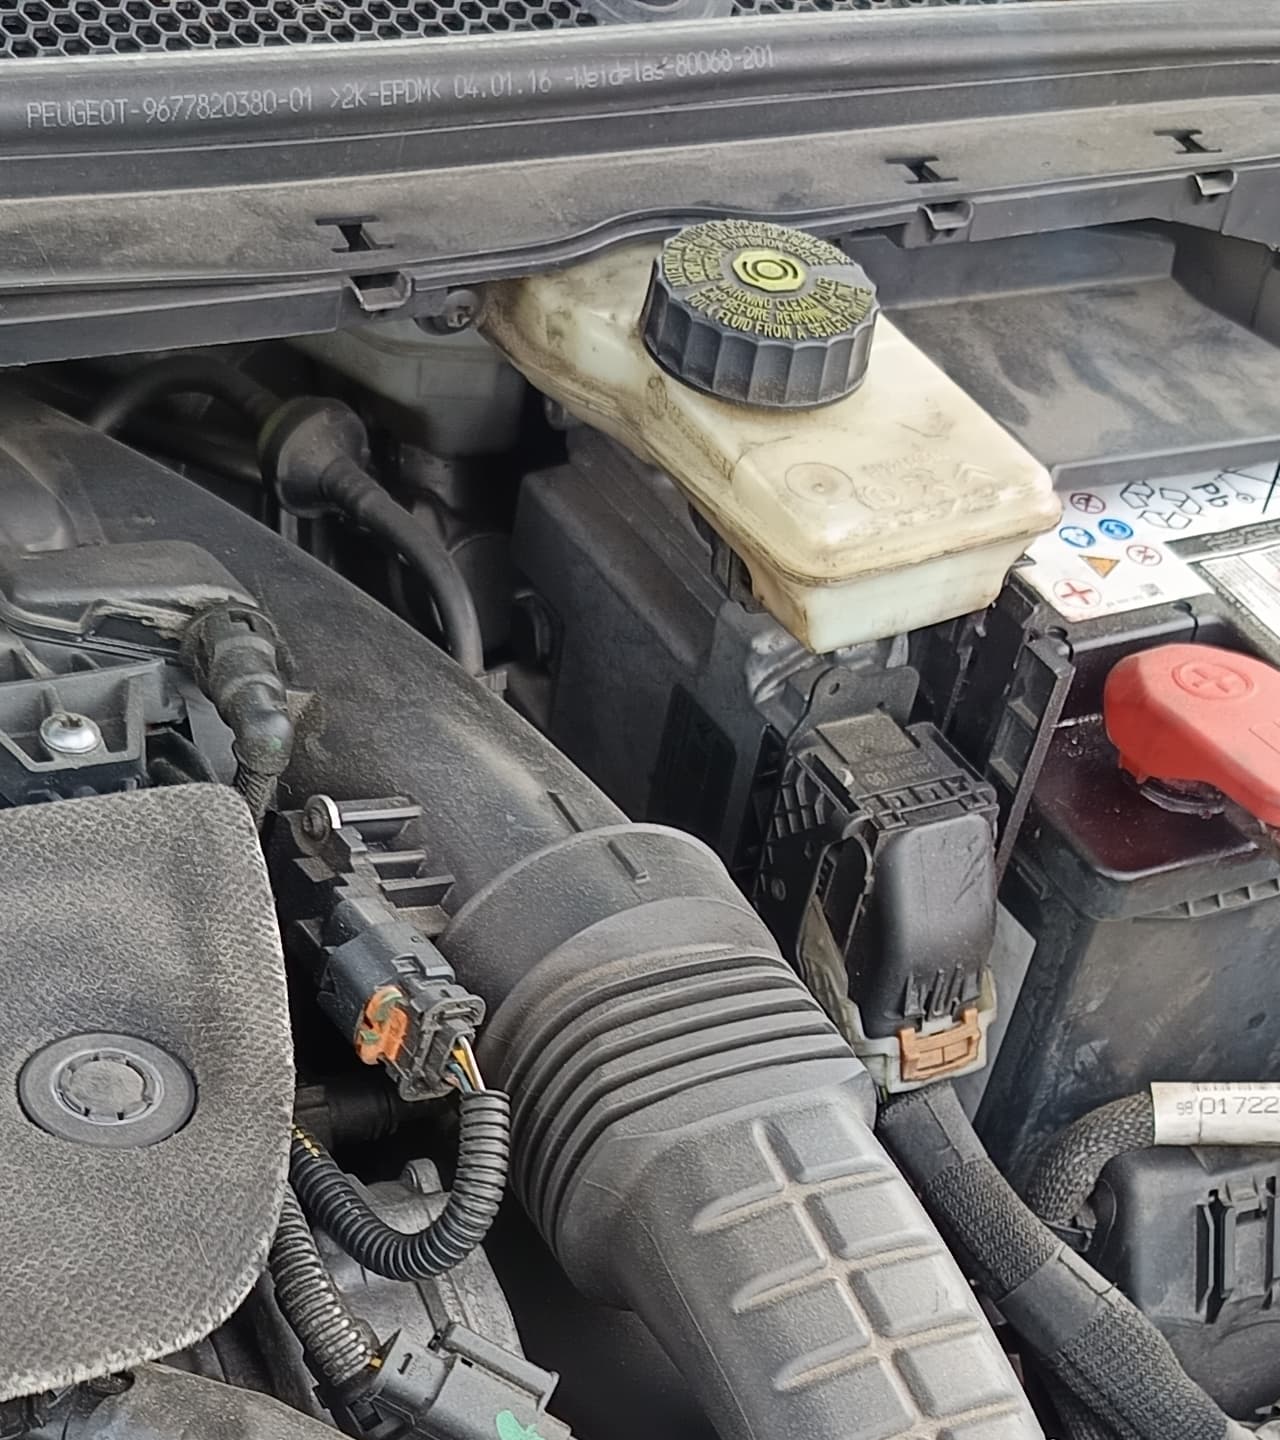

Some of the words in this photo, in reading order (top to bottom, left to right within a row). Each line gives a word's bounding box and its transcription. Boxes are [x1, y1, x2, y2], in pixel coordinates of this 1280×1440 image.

[26, 86, 313, 129] PEUGEOT-9677820380-01
[453, 70, 553, 100] 04.01.16
[716, 308, 753, 331] FLUID
[755, 320, 791, 339] FROM
[796, 324, 807, 340] A
[722, 297, 770, 322] BEFORE
[1191, 482, 1229, 508] Pb
